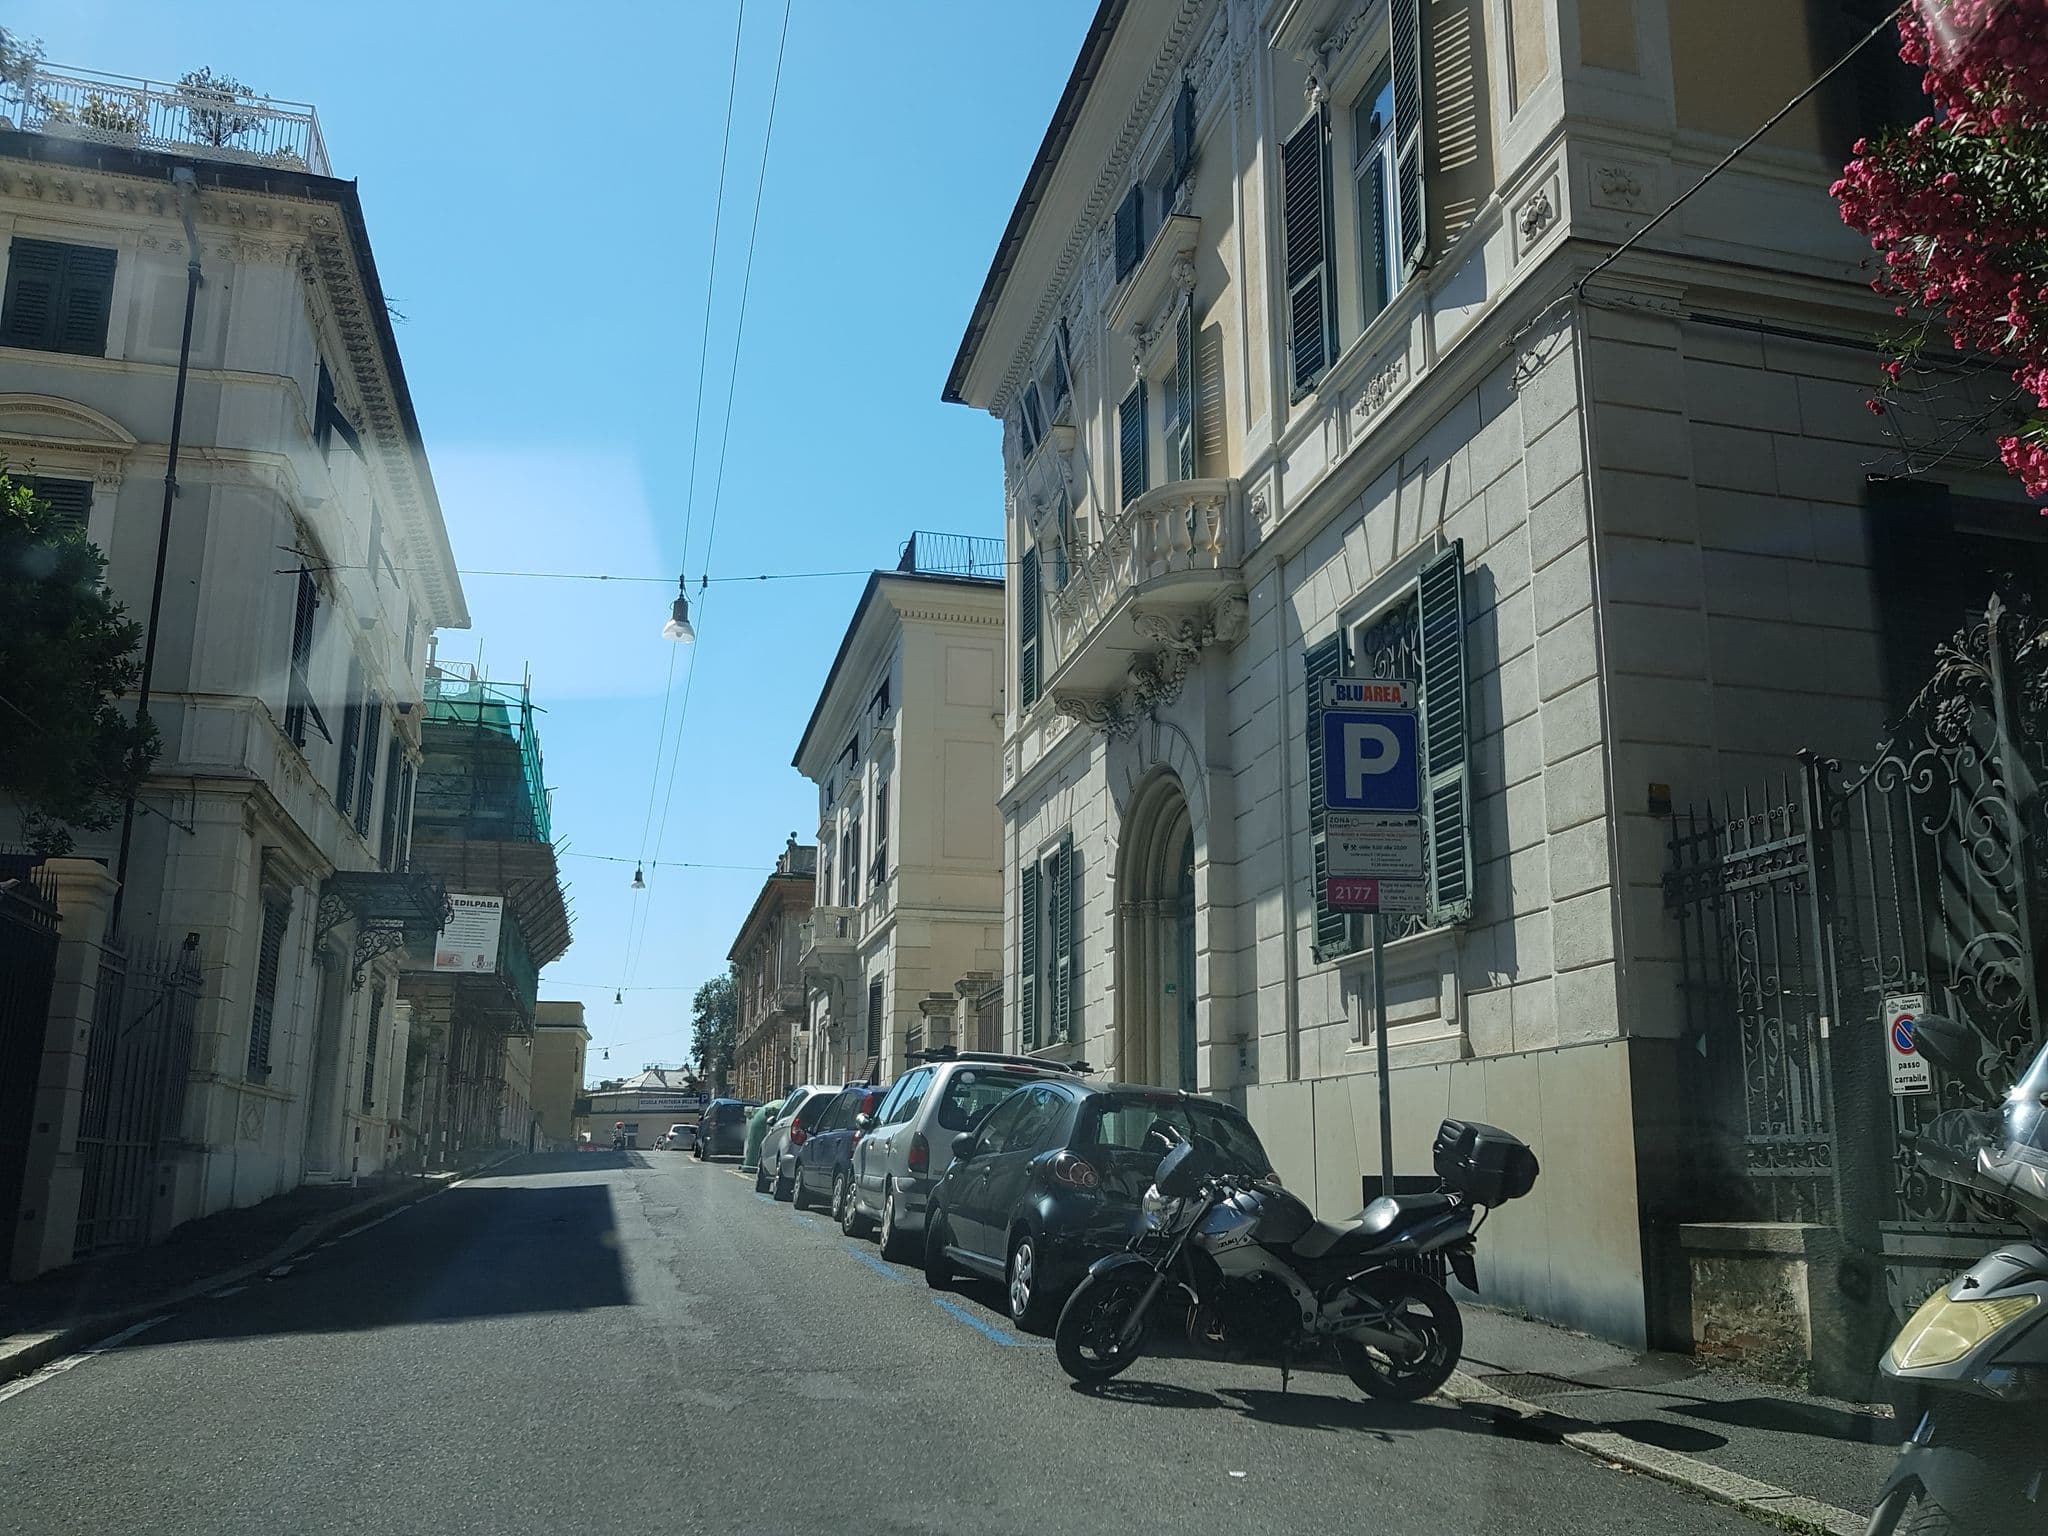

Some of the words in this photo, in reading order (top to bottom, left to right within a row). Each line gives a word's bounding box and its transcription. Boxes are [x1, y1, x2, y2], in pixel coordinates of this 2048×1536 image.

[1337, 684, 1401, 702] BLUAREA
[1343, 723, 1400, 799] P
[1335, 886, 1371, 900] 2177
[1898, 1061, 1921, 1071] passo
[1895, 1073, 1926, 1084] carrabile
[701, 1094, 709, 1102] P
